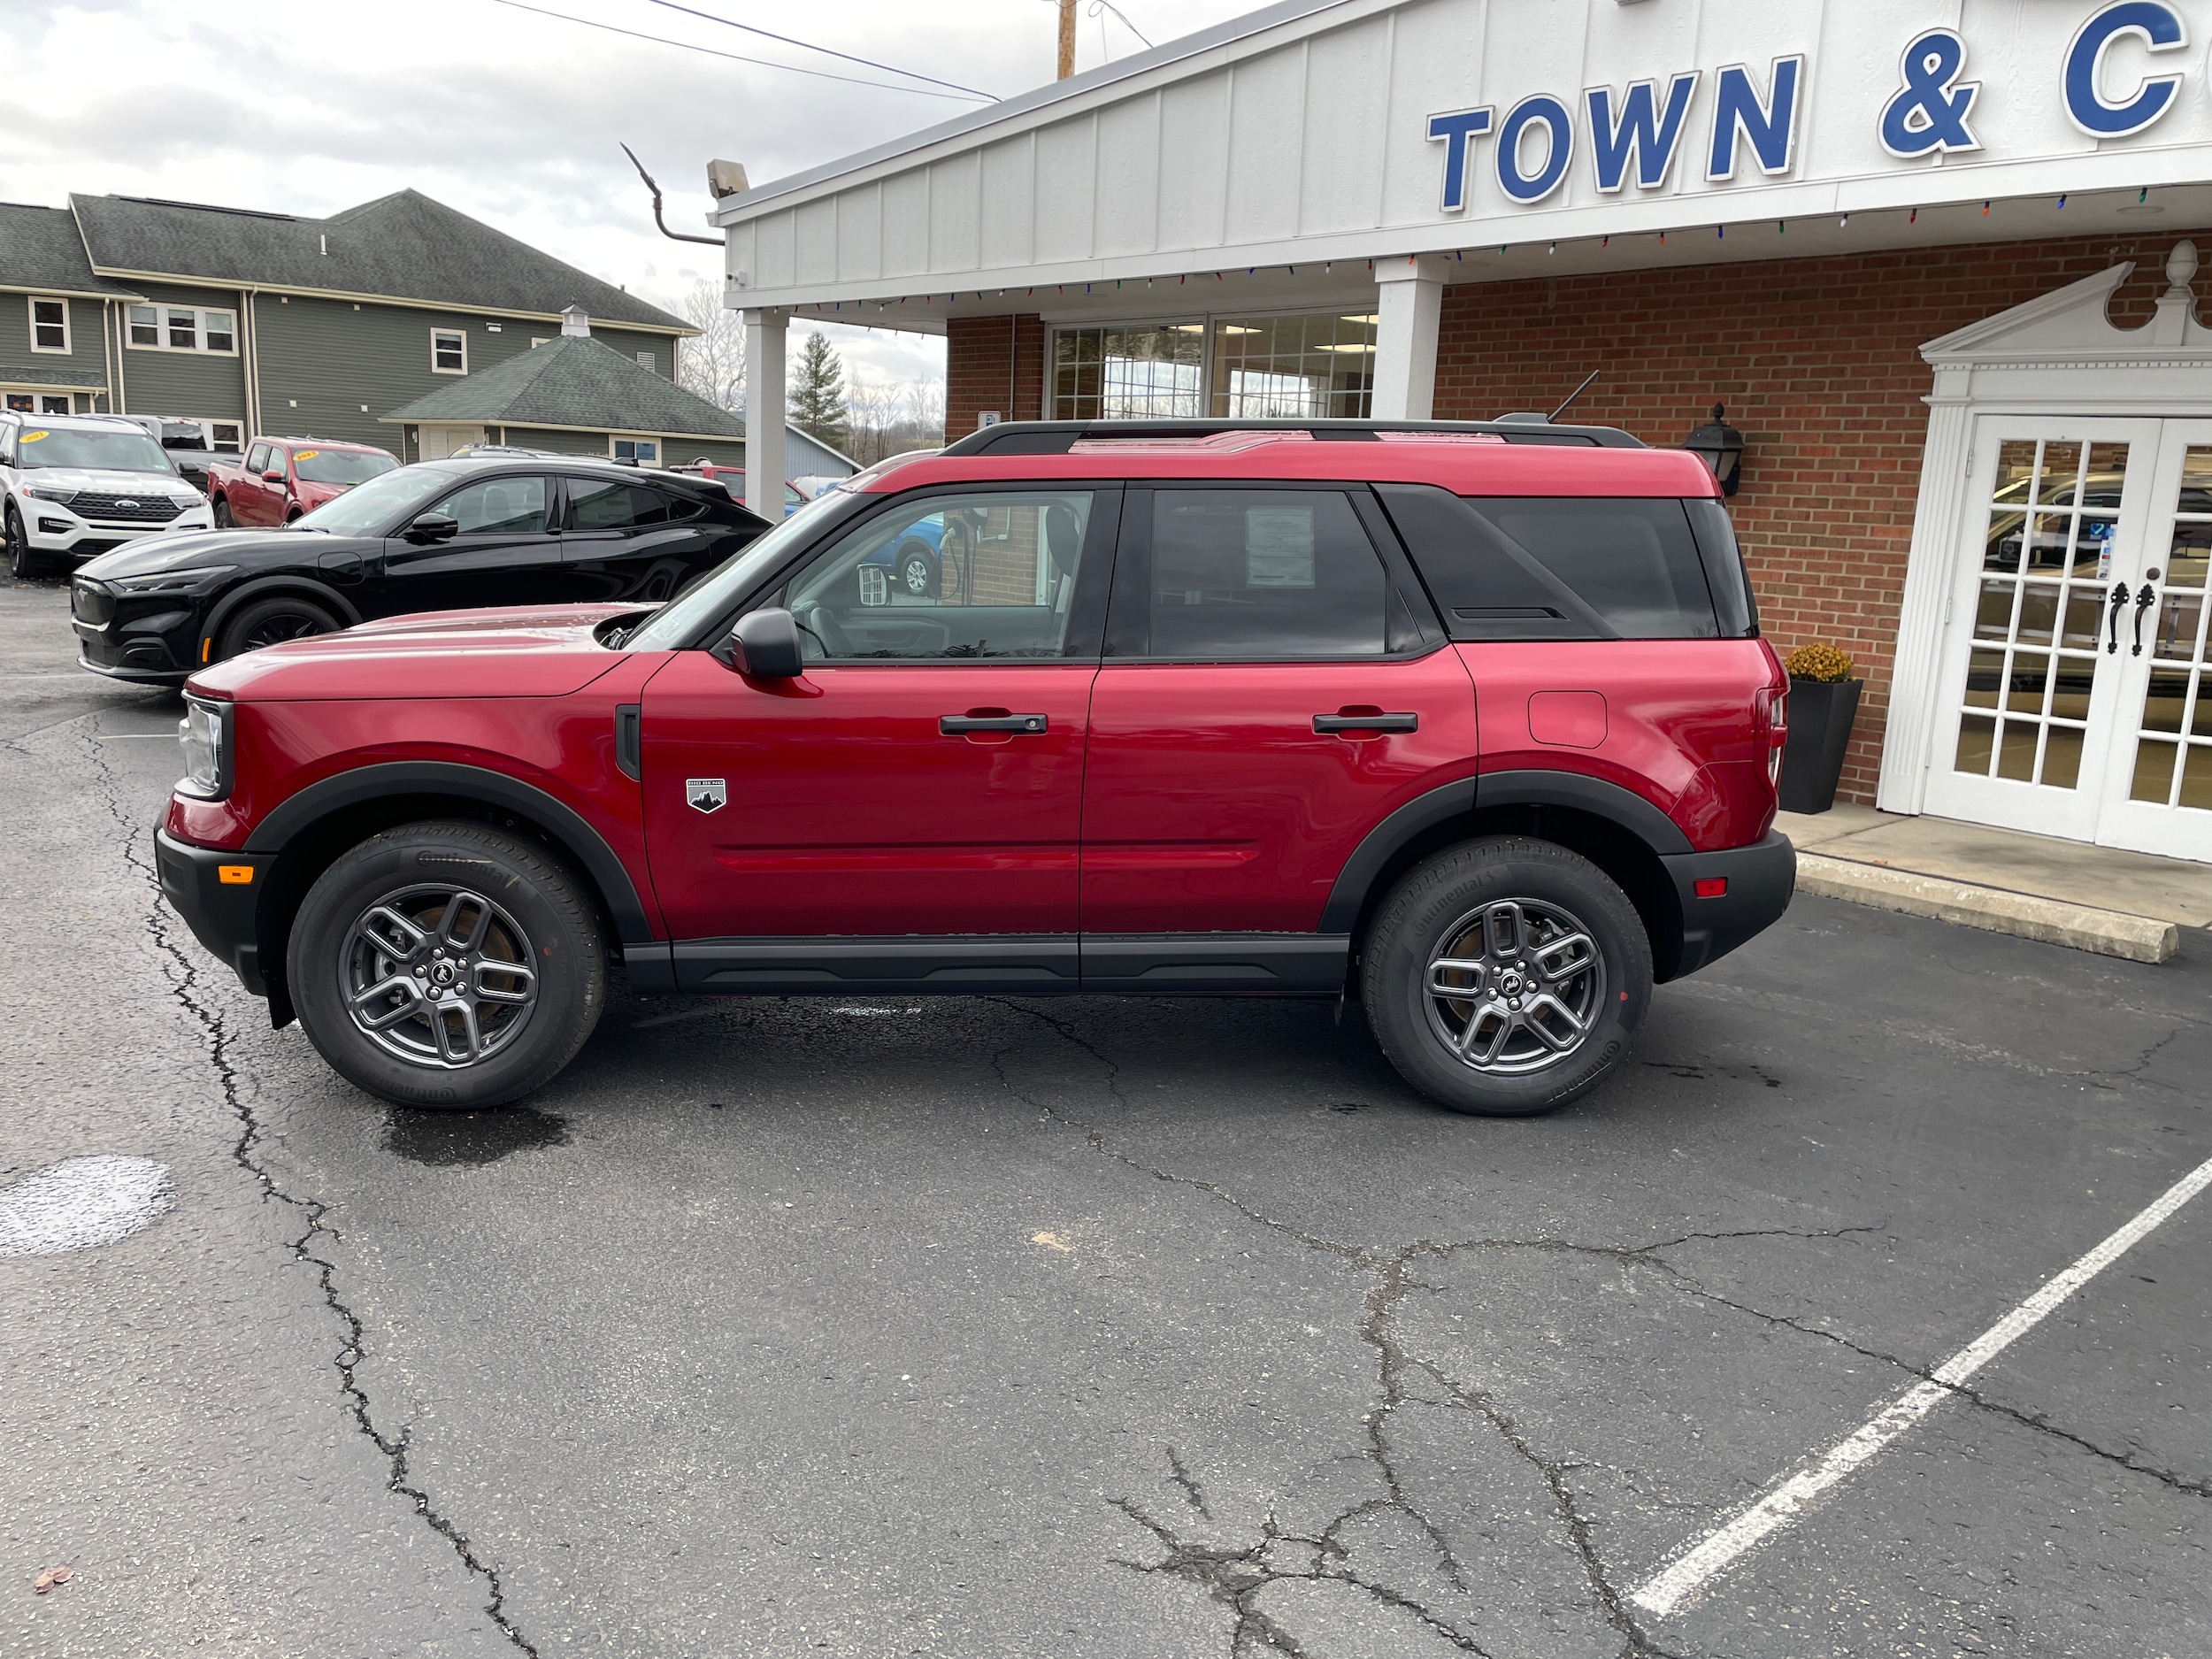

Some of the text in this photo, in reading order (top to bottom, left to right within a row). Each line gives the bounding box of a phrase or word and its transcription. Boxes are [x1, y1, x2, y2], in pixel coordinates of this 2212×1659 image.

[1426, 0, 2212, 211] TOWN & C
[1414, 873, 1490, 938] Continental
